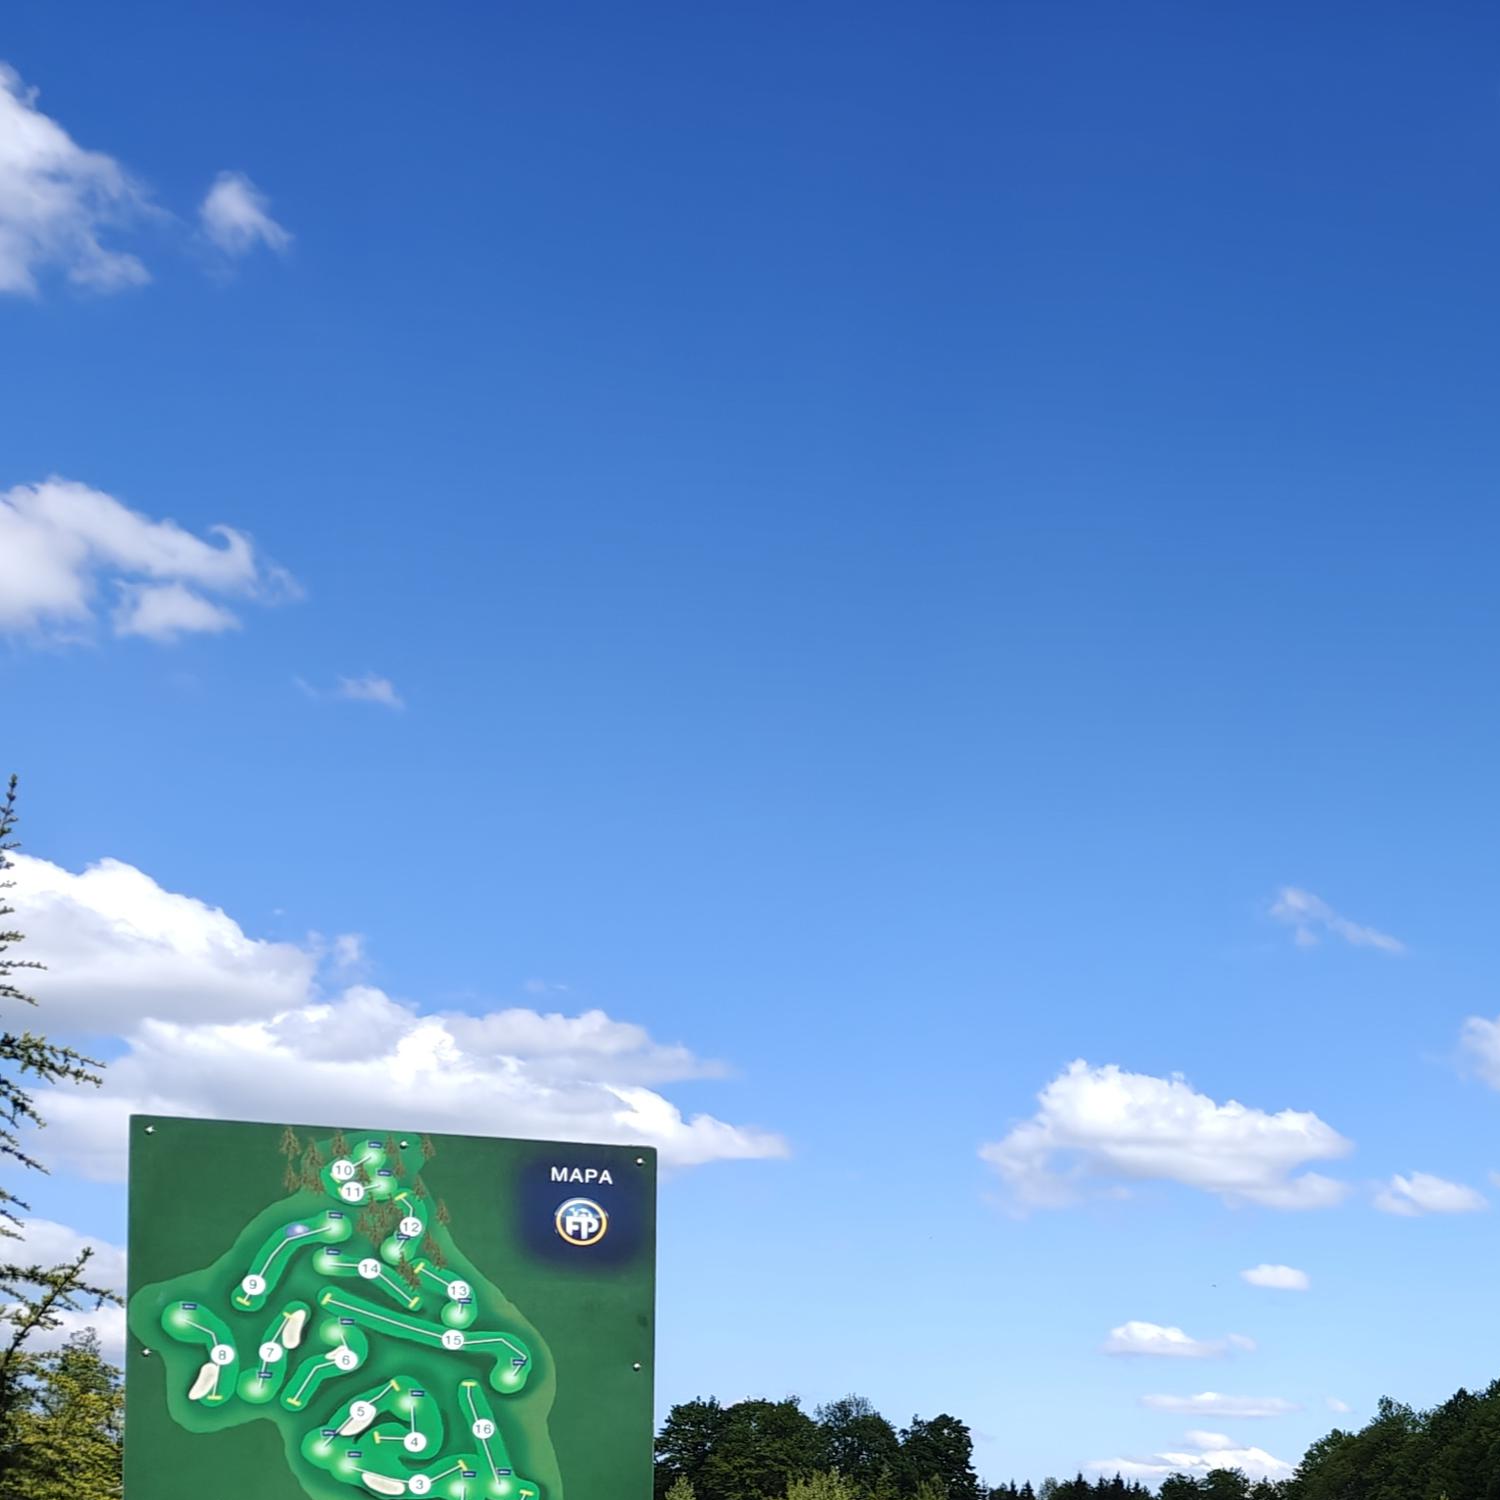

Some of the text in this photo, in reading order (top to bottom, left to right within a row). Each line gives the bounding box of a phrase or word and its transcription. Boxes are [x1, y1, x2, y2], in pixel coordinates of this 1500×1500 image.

[336, 1164, 353, 1176] 10
[551, 1166, 613, 1185] MAPA
[345, 1186, 360, 1198] 11
[403, 1221, 420, 1234] 12
[362, 1263, 379, 1274] 14
[248, 1278, 258, 1290] 9
[451, 1285, 467, 1297] 13
[445, 1334, 462, 1346] 15
[218, 1349, 227, 1361] 8
[266, 1347, 275, 1358] 7
[341, 1354, 350, 1366] 6
[356, 1406, 366, 1417] 5
[475, 1423, 492, 1435] 16
[410, 1436, 419, 1447] 4
[415, 1479, 424, 1490] 3
